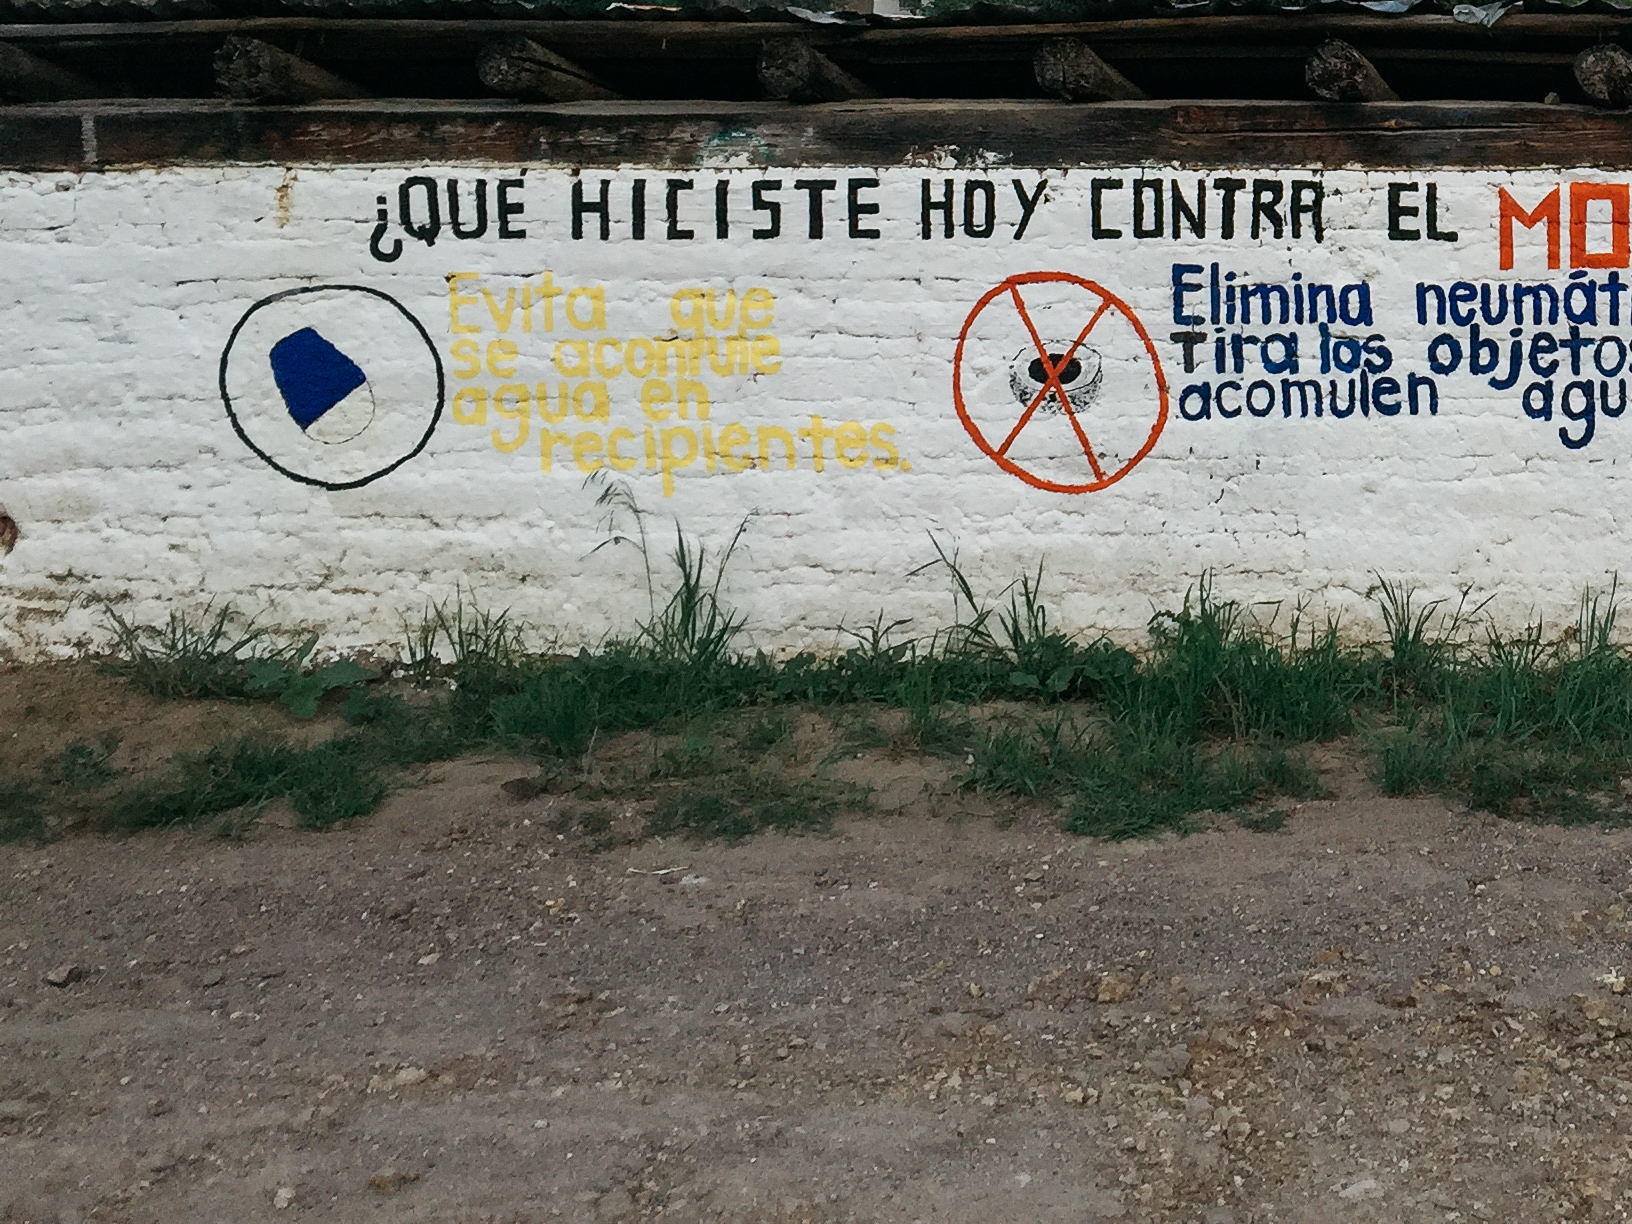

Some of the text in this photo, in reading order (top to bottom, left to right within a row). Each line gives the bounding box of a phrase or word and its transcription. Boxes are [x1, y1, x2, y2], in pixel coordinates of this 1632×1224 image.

[571, 177, 881, 240] HICISTE
[921, 178, 1048, 241] HOY
[1091, 177, 1324, 243] CONTRA
[1387, 182, 1458, 242] EL
[448, 270, 777, 343] Evita que
[1172, 262, 1374, 327] Elimina
[450, 338, 518, 380] se
[1169, 327, 1299, 375] Tira
[1319, 322, 1393, 375] los
[452, 378, 711, 453] agua en
[1179, 368, 1439, 422] acomulen
[540, 414, 912, 498] recipientes.
